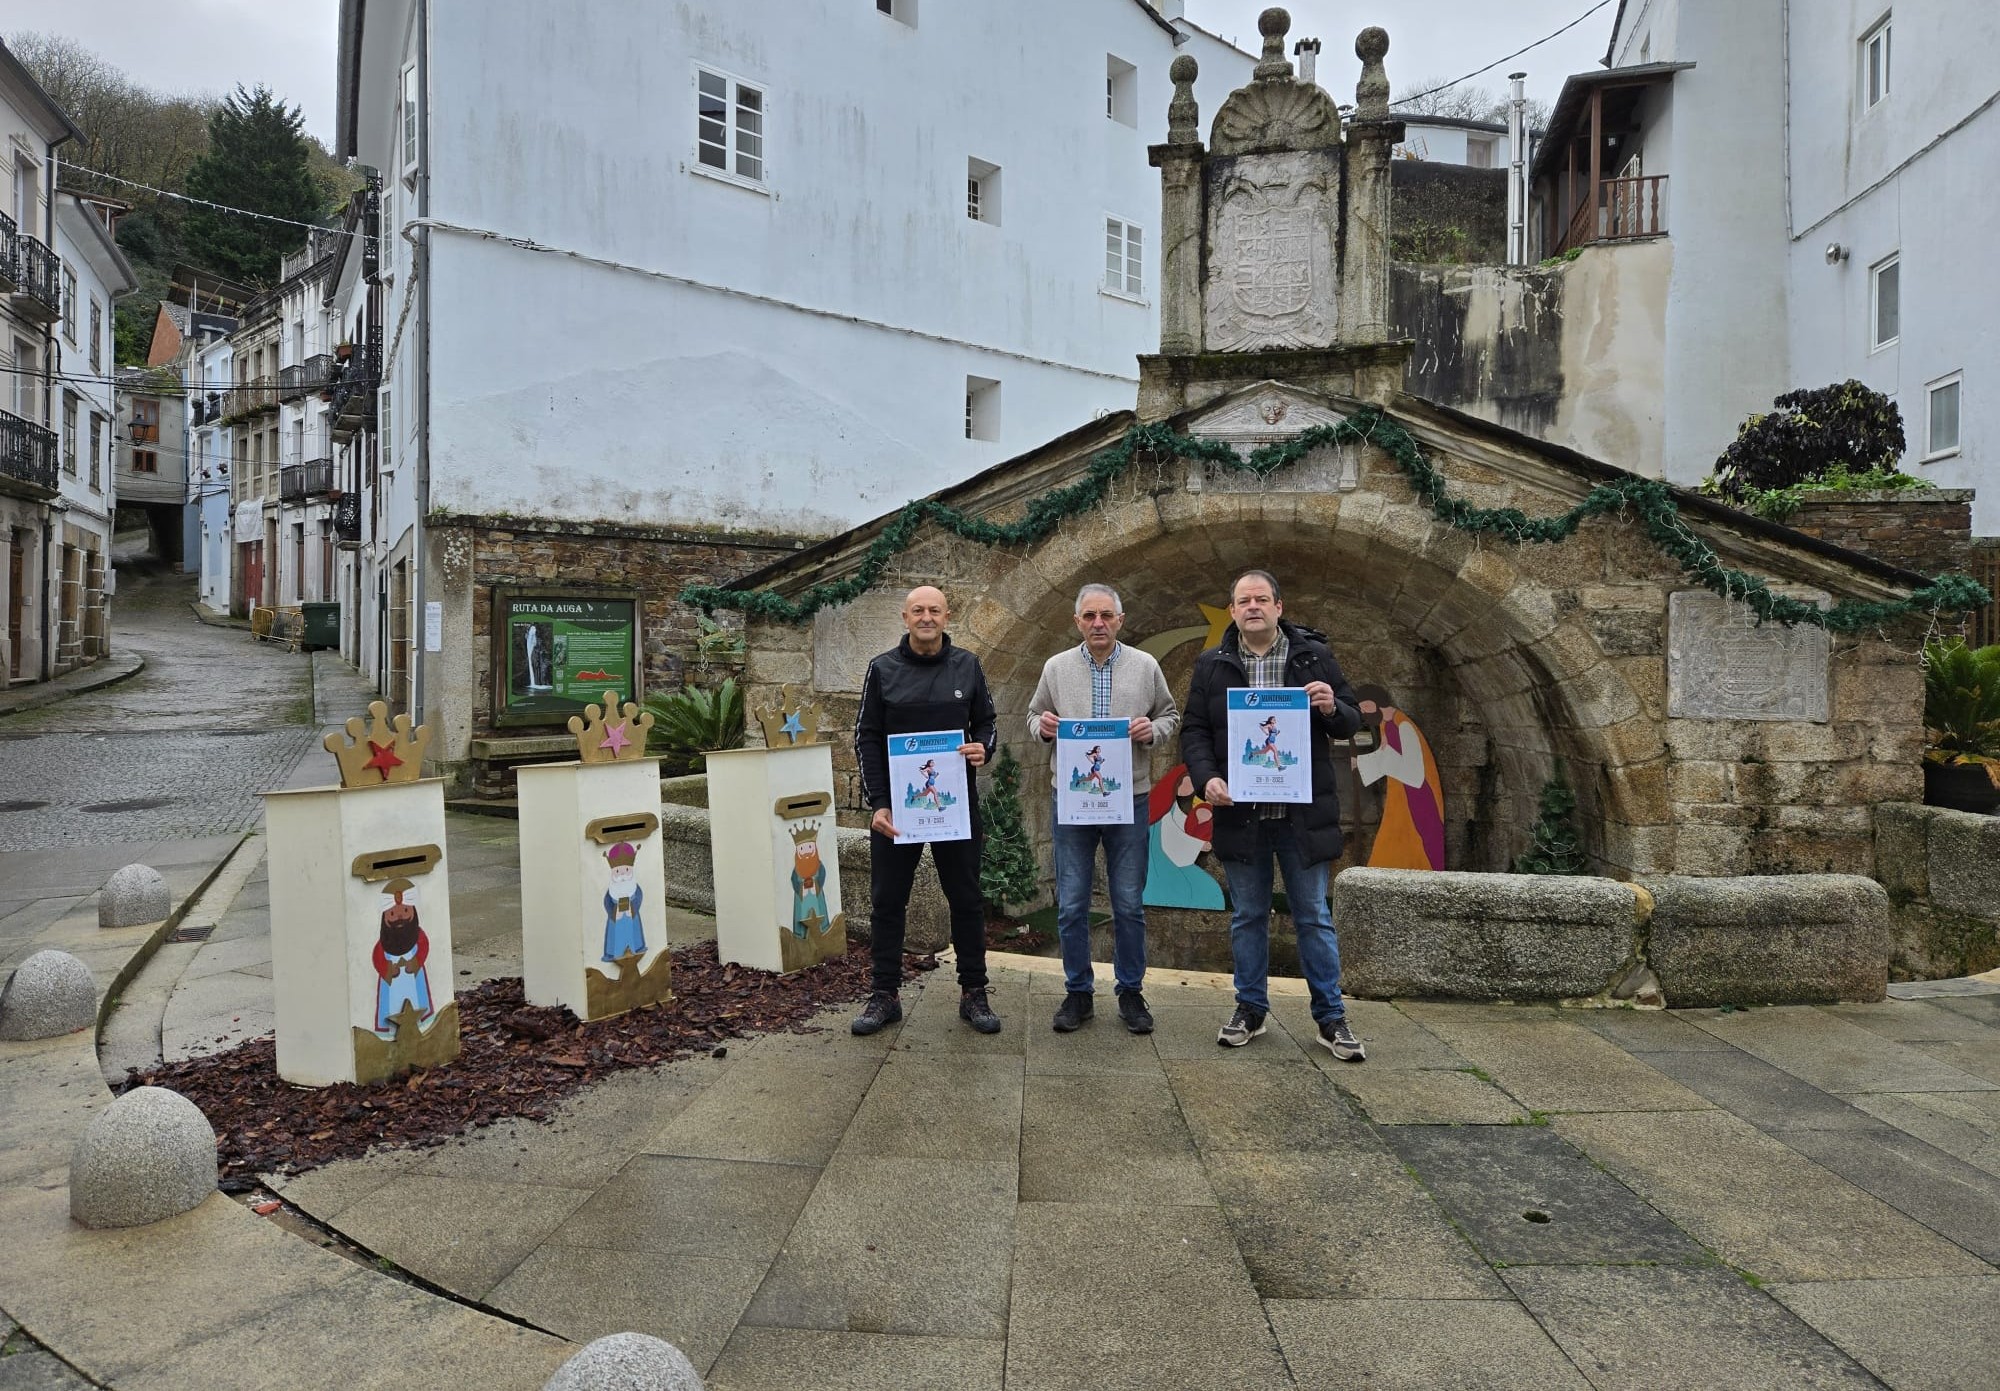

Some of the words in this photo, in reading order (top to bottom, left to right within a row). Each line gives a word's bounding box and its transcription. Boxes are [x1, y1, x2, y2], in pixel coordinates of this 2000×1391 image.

[512, 603, 538, 612] RUTA
[540, 604, 554, 613] DA
[556, 604, 583, 613] AUGA
